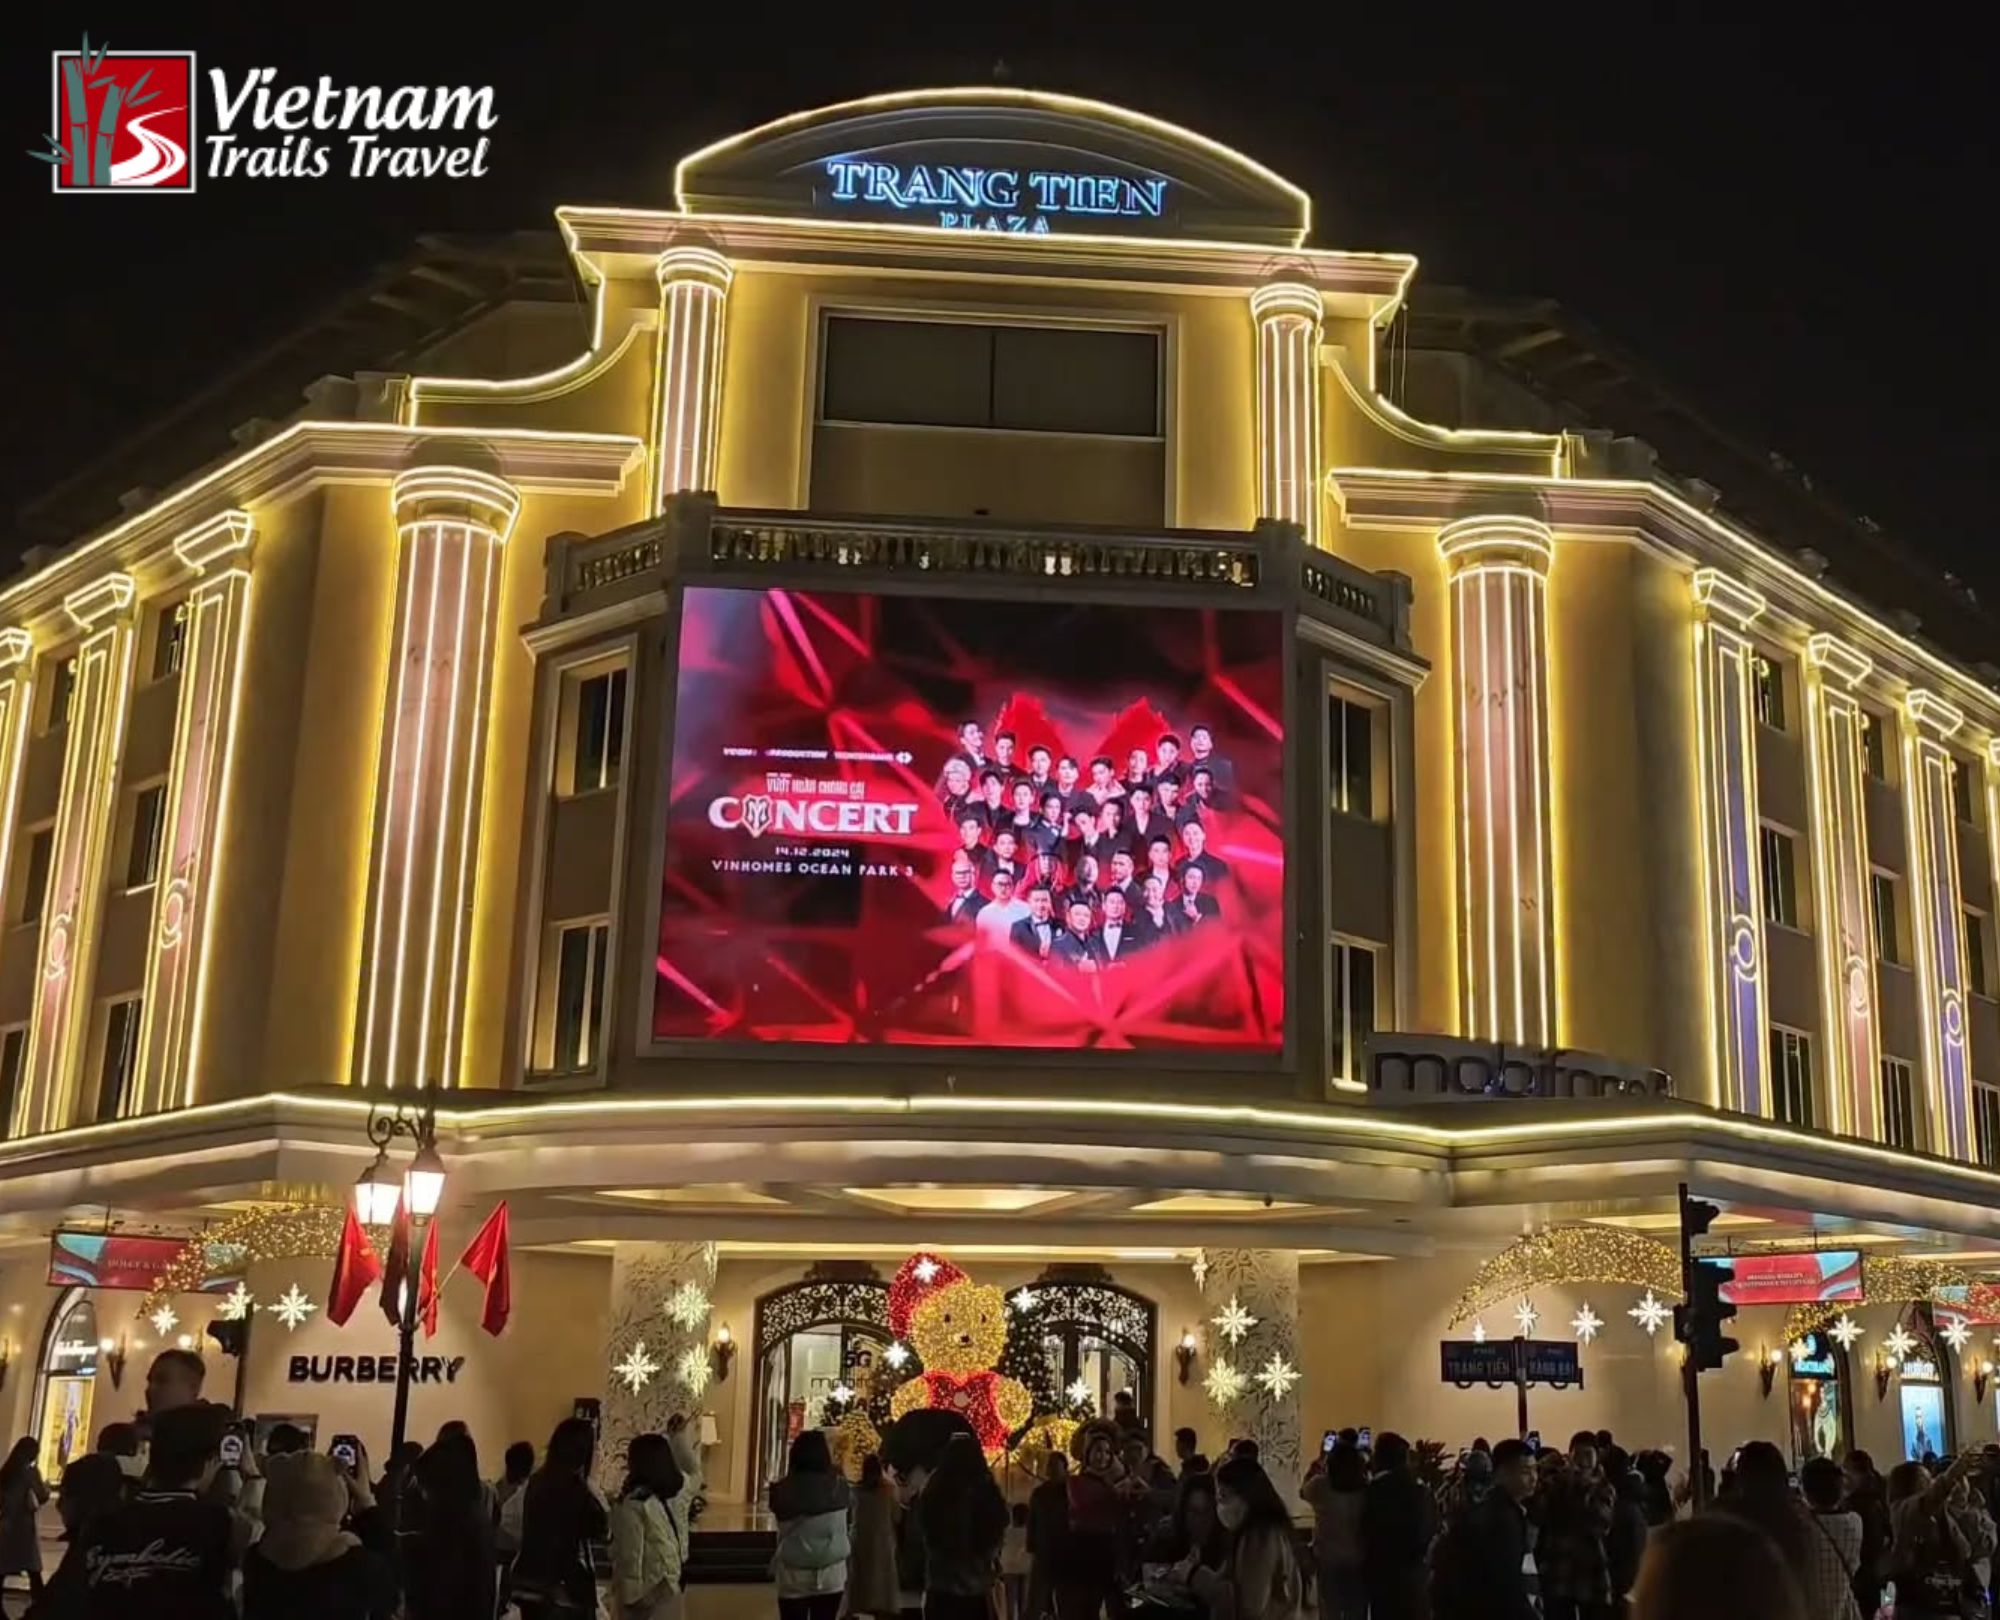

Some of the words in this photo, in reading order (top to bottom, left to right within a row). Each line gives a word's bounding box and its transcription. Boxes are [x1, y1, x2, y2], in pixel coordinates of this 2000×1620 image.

[827, 160, 1019, 208] TRANG
[1029, 171, 1167, 216] TIEN
[940, 211, 1050, 235] PLAZA
[775, 846, 850, 858] 14.12.2024
[711, 860, 792, 874] VINHOMES
[798, 862, 851, 875] OCEAN
[859, 864, 898, 876] PARK
[288, 1356, 465, 1383] BURBERRY
